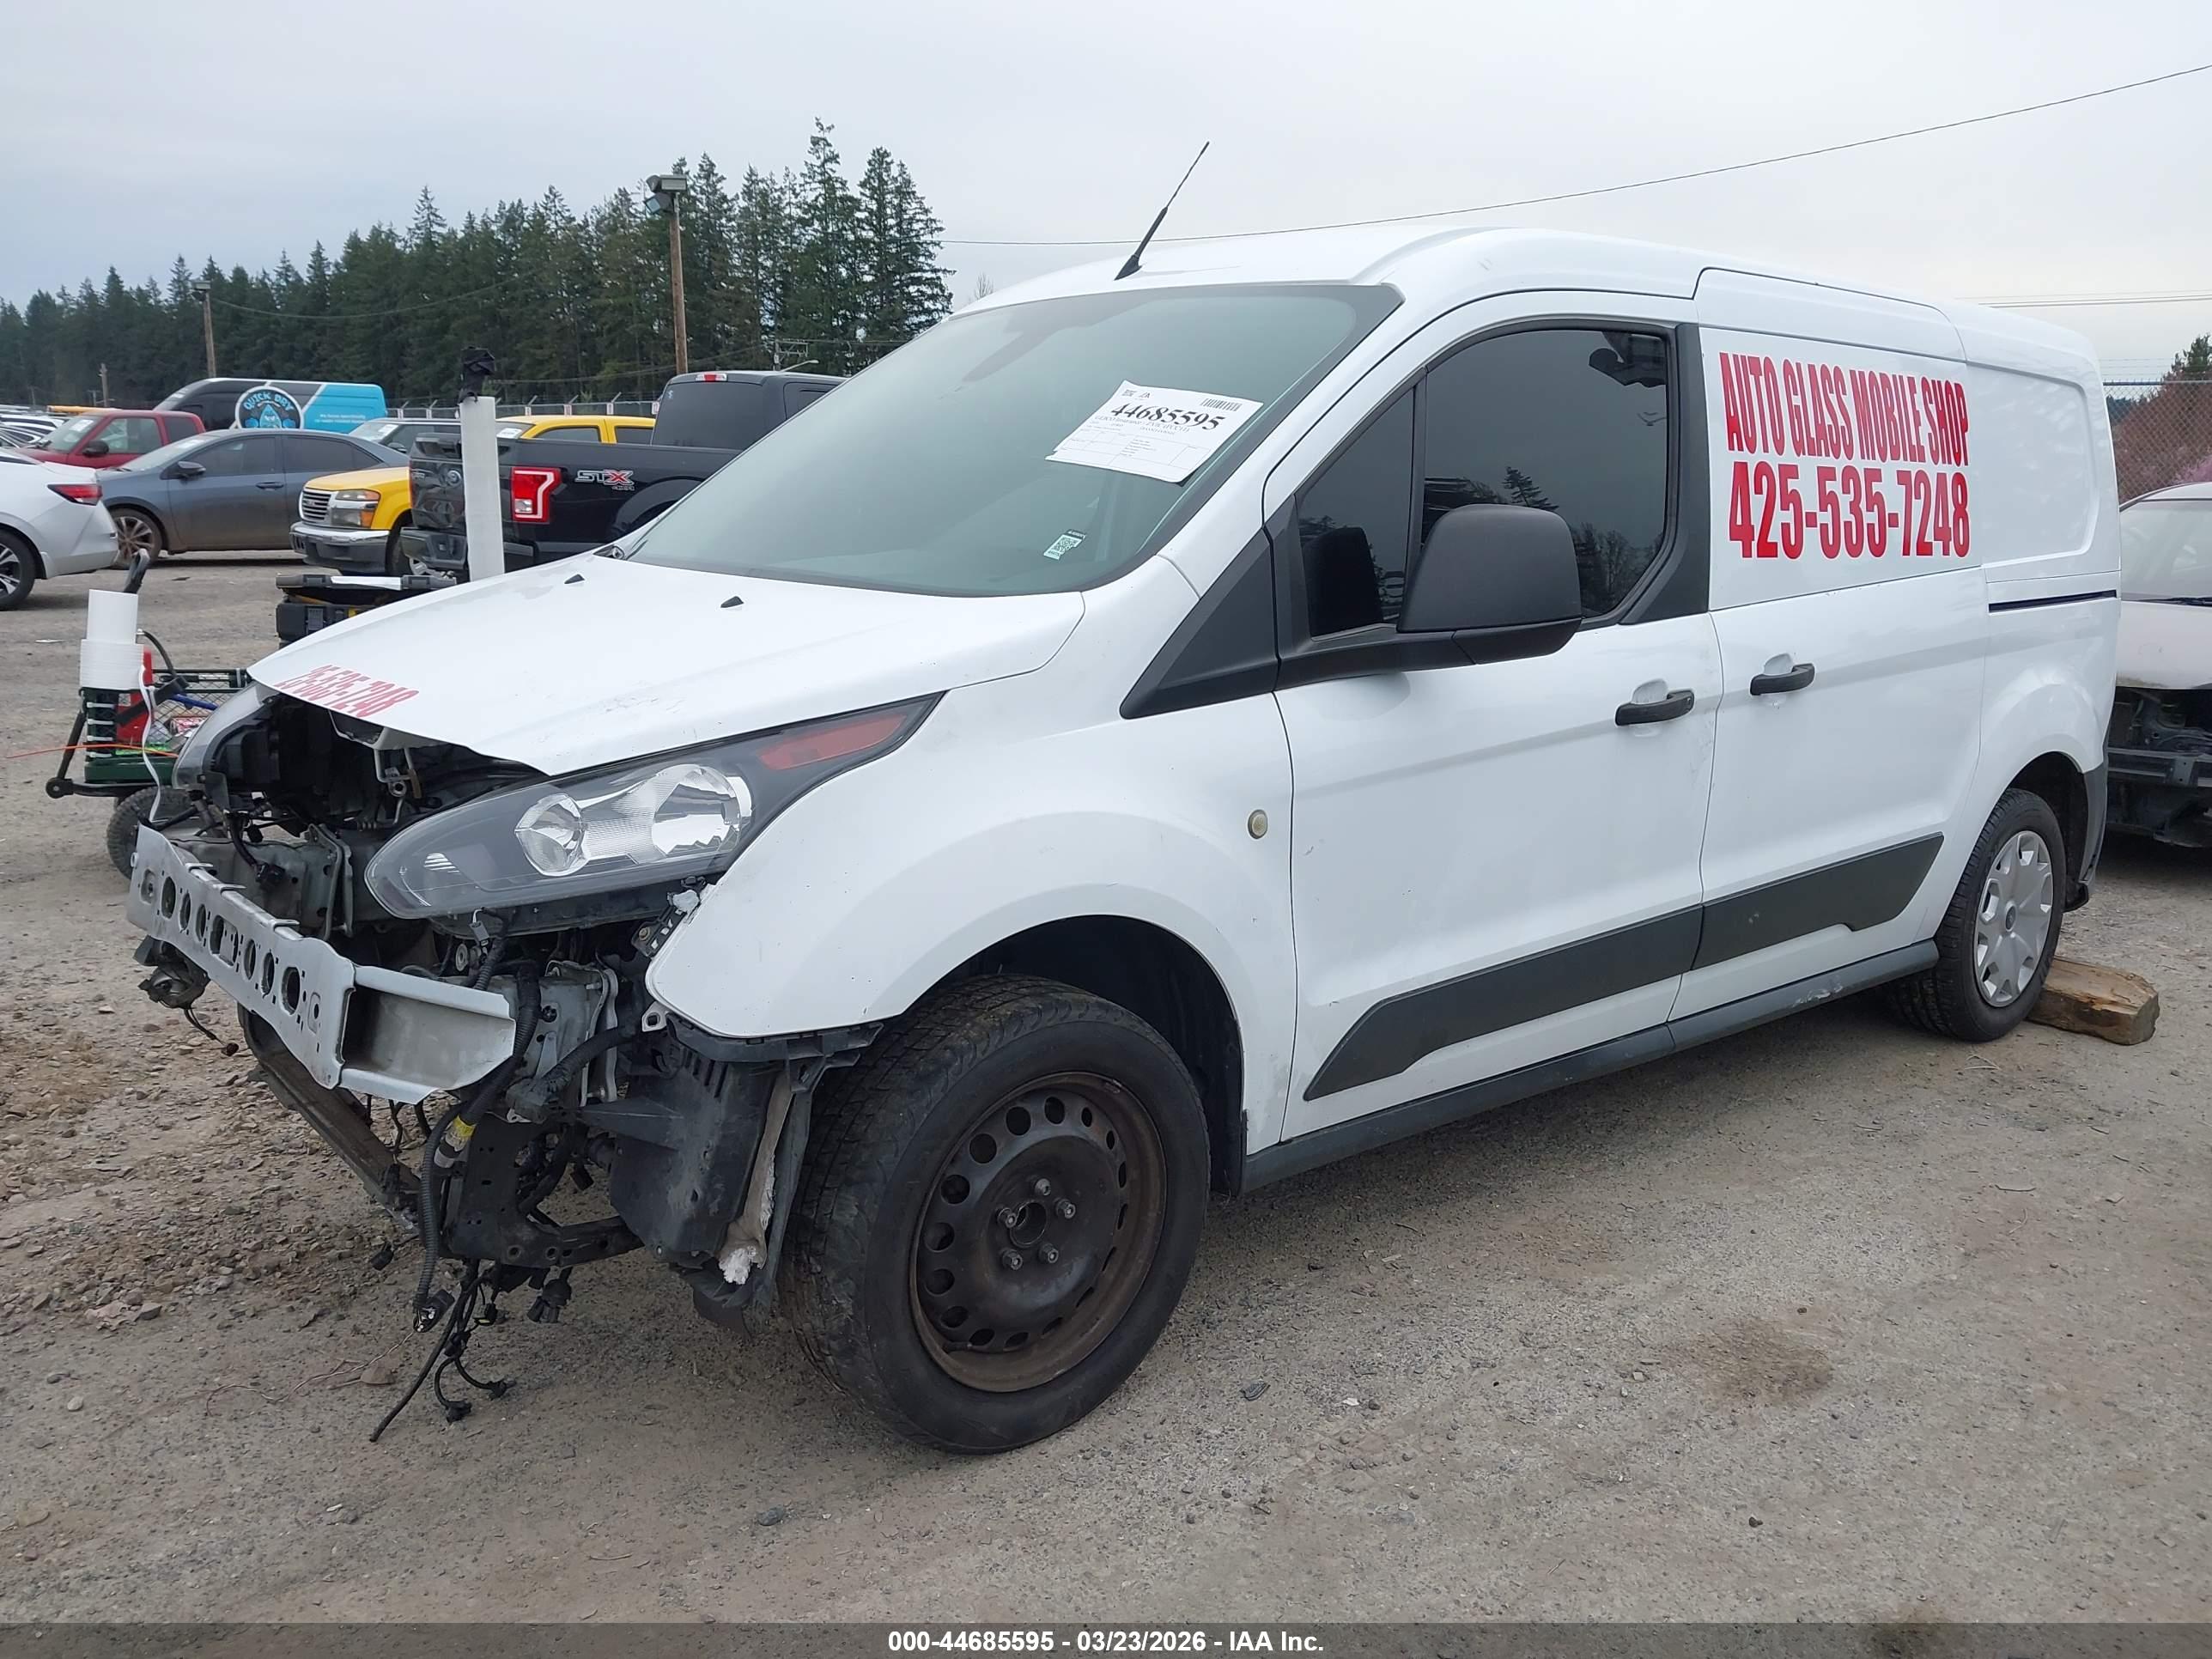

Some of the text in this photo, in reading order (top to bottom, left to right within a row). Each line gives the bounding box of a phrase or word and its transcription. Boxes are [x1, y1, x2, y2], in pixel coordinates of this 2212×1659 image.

[243, 391, 295, 411] QUICK DRY
[1719, 351, 1969, 467] AUTO GLASS MOBILE SHOP
[1110, 402, 1226, 431] 44685595
[574, 469, 635, 486] STX
[1729, 460, 1971, 560] 425-535-7248
